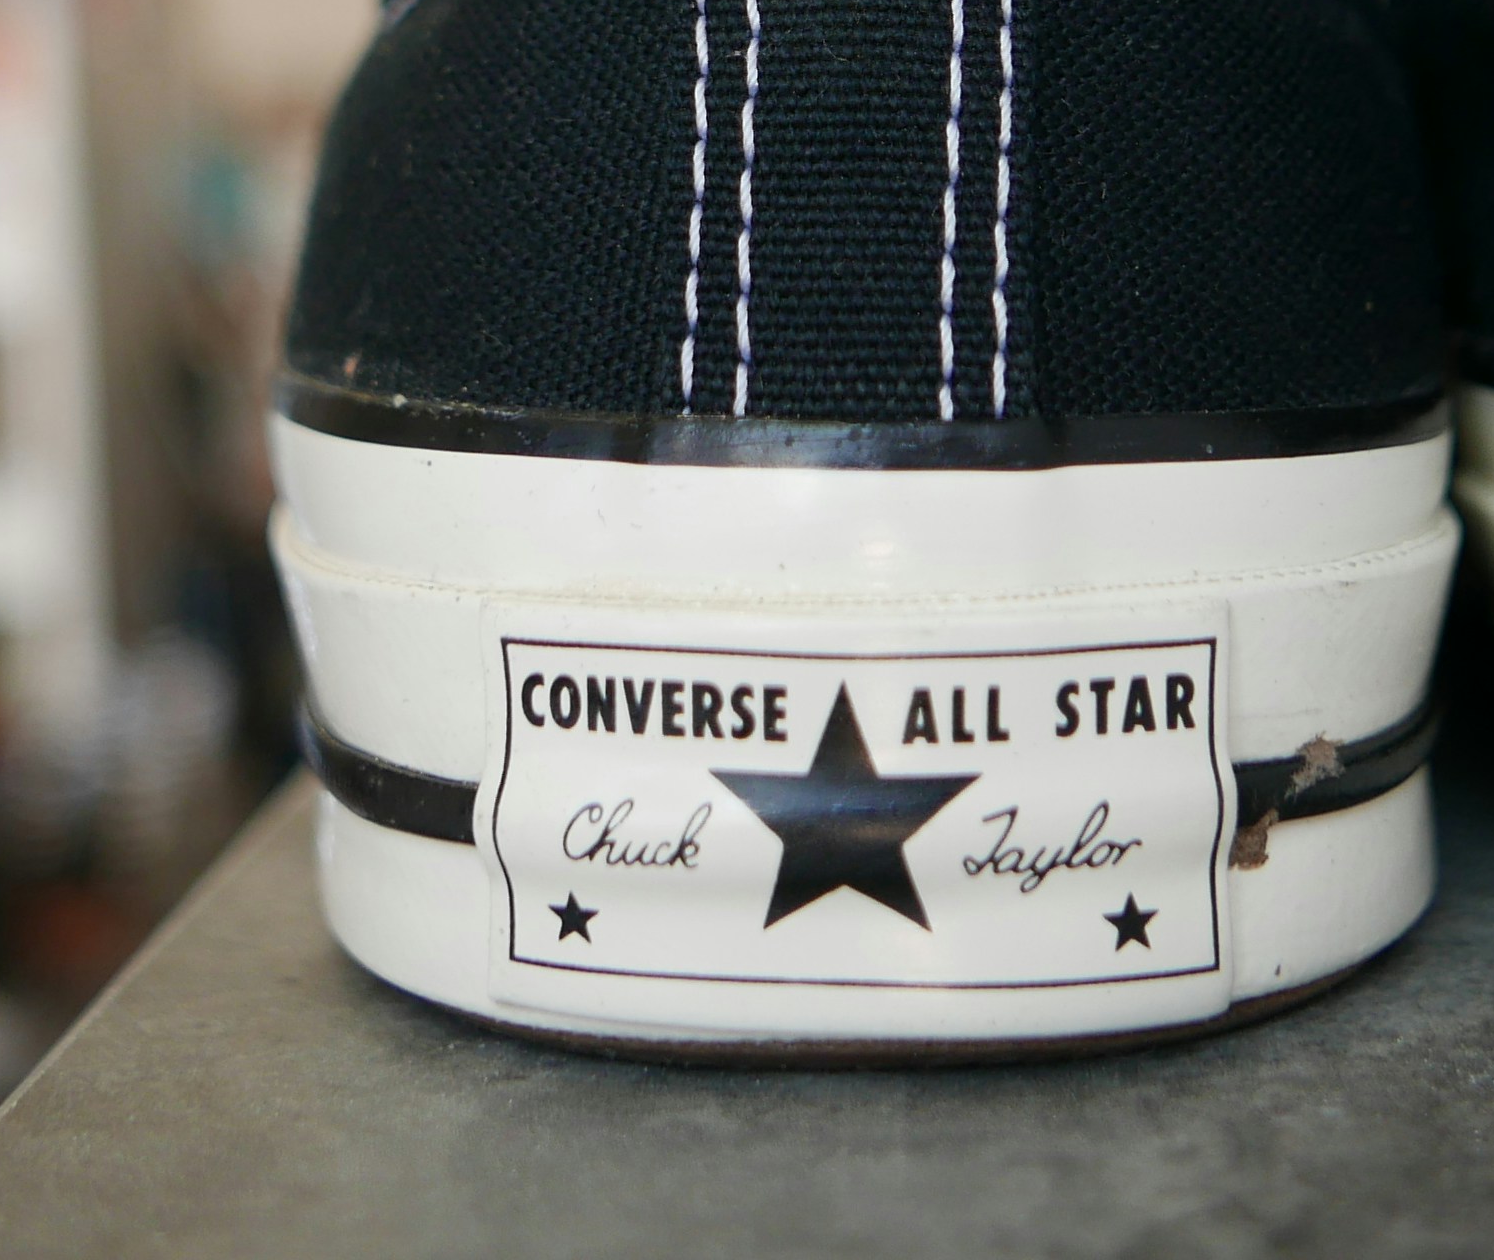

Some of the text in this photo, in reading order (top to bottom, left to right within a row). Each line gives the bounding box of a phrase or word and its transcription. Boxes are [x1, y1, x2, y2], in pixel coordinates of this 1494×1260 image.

[520, 671, 1197, 745] CONVERSE ALL STAR
[561, 798, 1144, 894] Chuck Taylor
